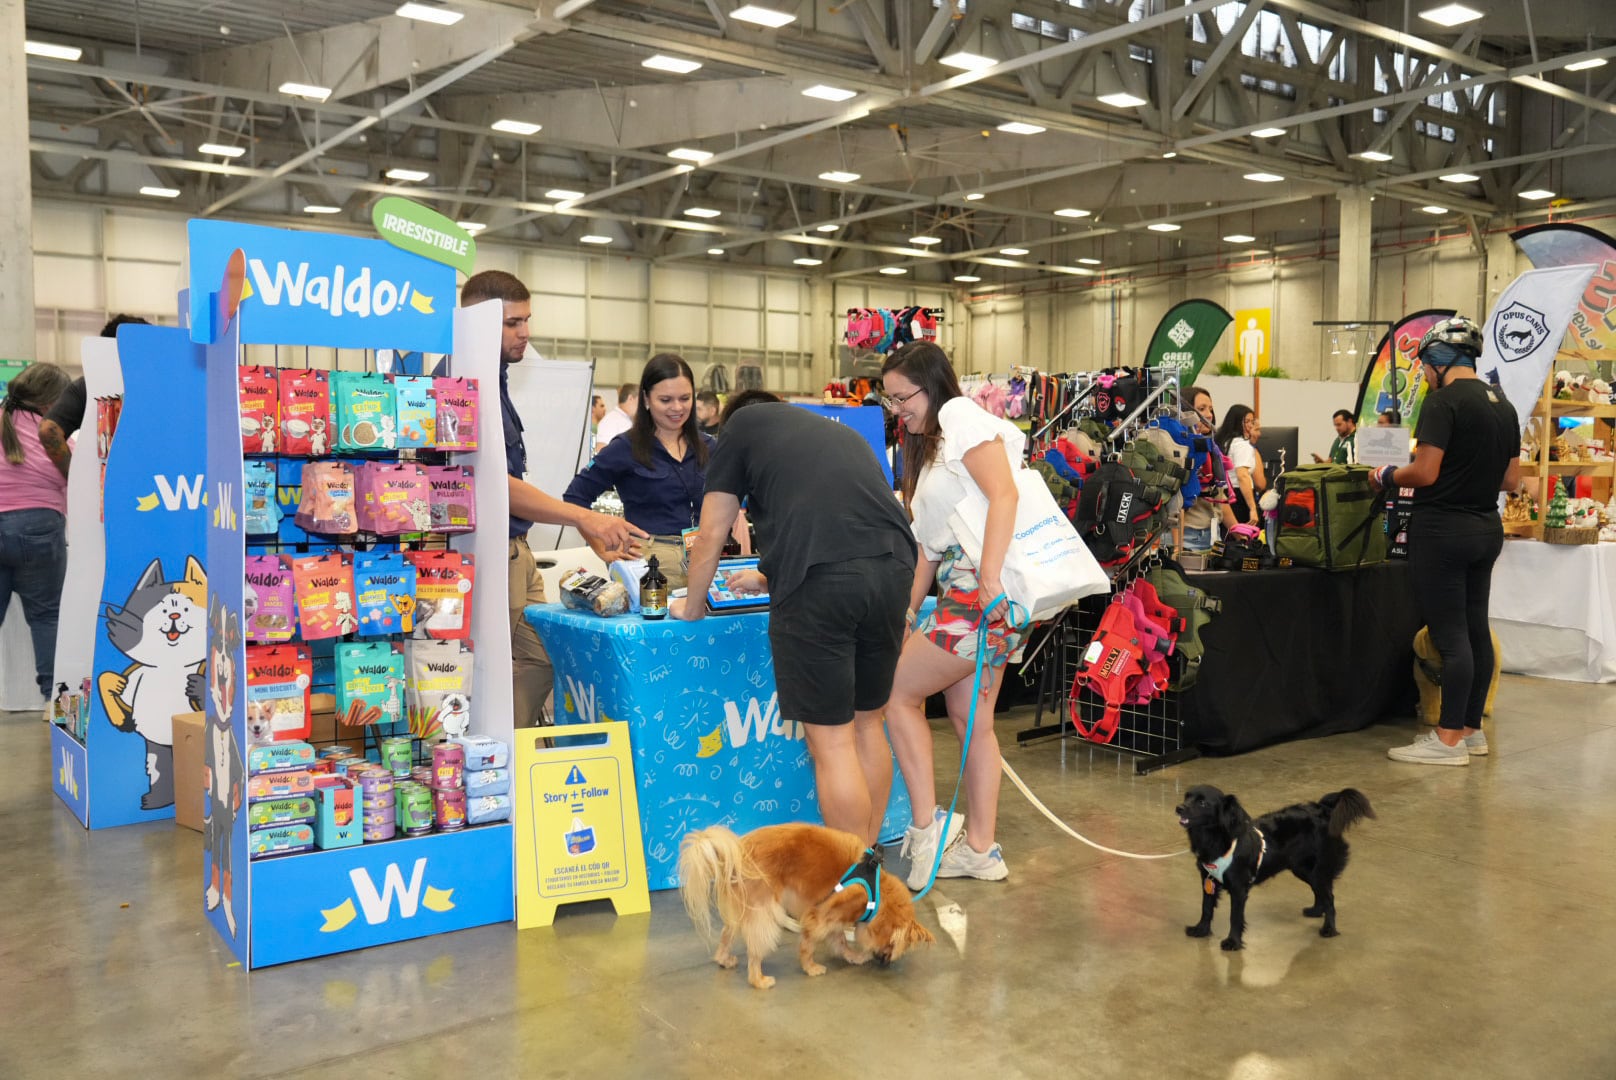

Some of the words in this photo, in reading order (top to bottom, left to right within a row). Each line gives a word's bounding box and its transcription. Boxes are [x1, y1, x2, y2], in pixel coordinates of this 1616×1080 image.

[382, 213, 469, 256] IRRESISTIBLE
[249, 258, 410, 318] Waldo!
[1503, 311, 1525, 320] OPUS
[1525, 314, 1545, 335] CANIS
[153, 473, 205, 511] W
[218, 482, 232, 529] W
[1117, 493, 1132, 523] JACK
[1100, 647, 1121, 678] MOLLY
[565, 674, 596, 724] W
[62, 744, 74, 796] W
[543, 792, 568, 804] Story
[581, 788, 609, 798] Follow
[338, 831, 349, 840] W
[348, 856, 428, 926] W
